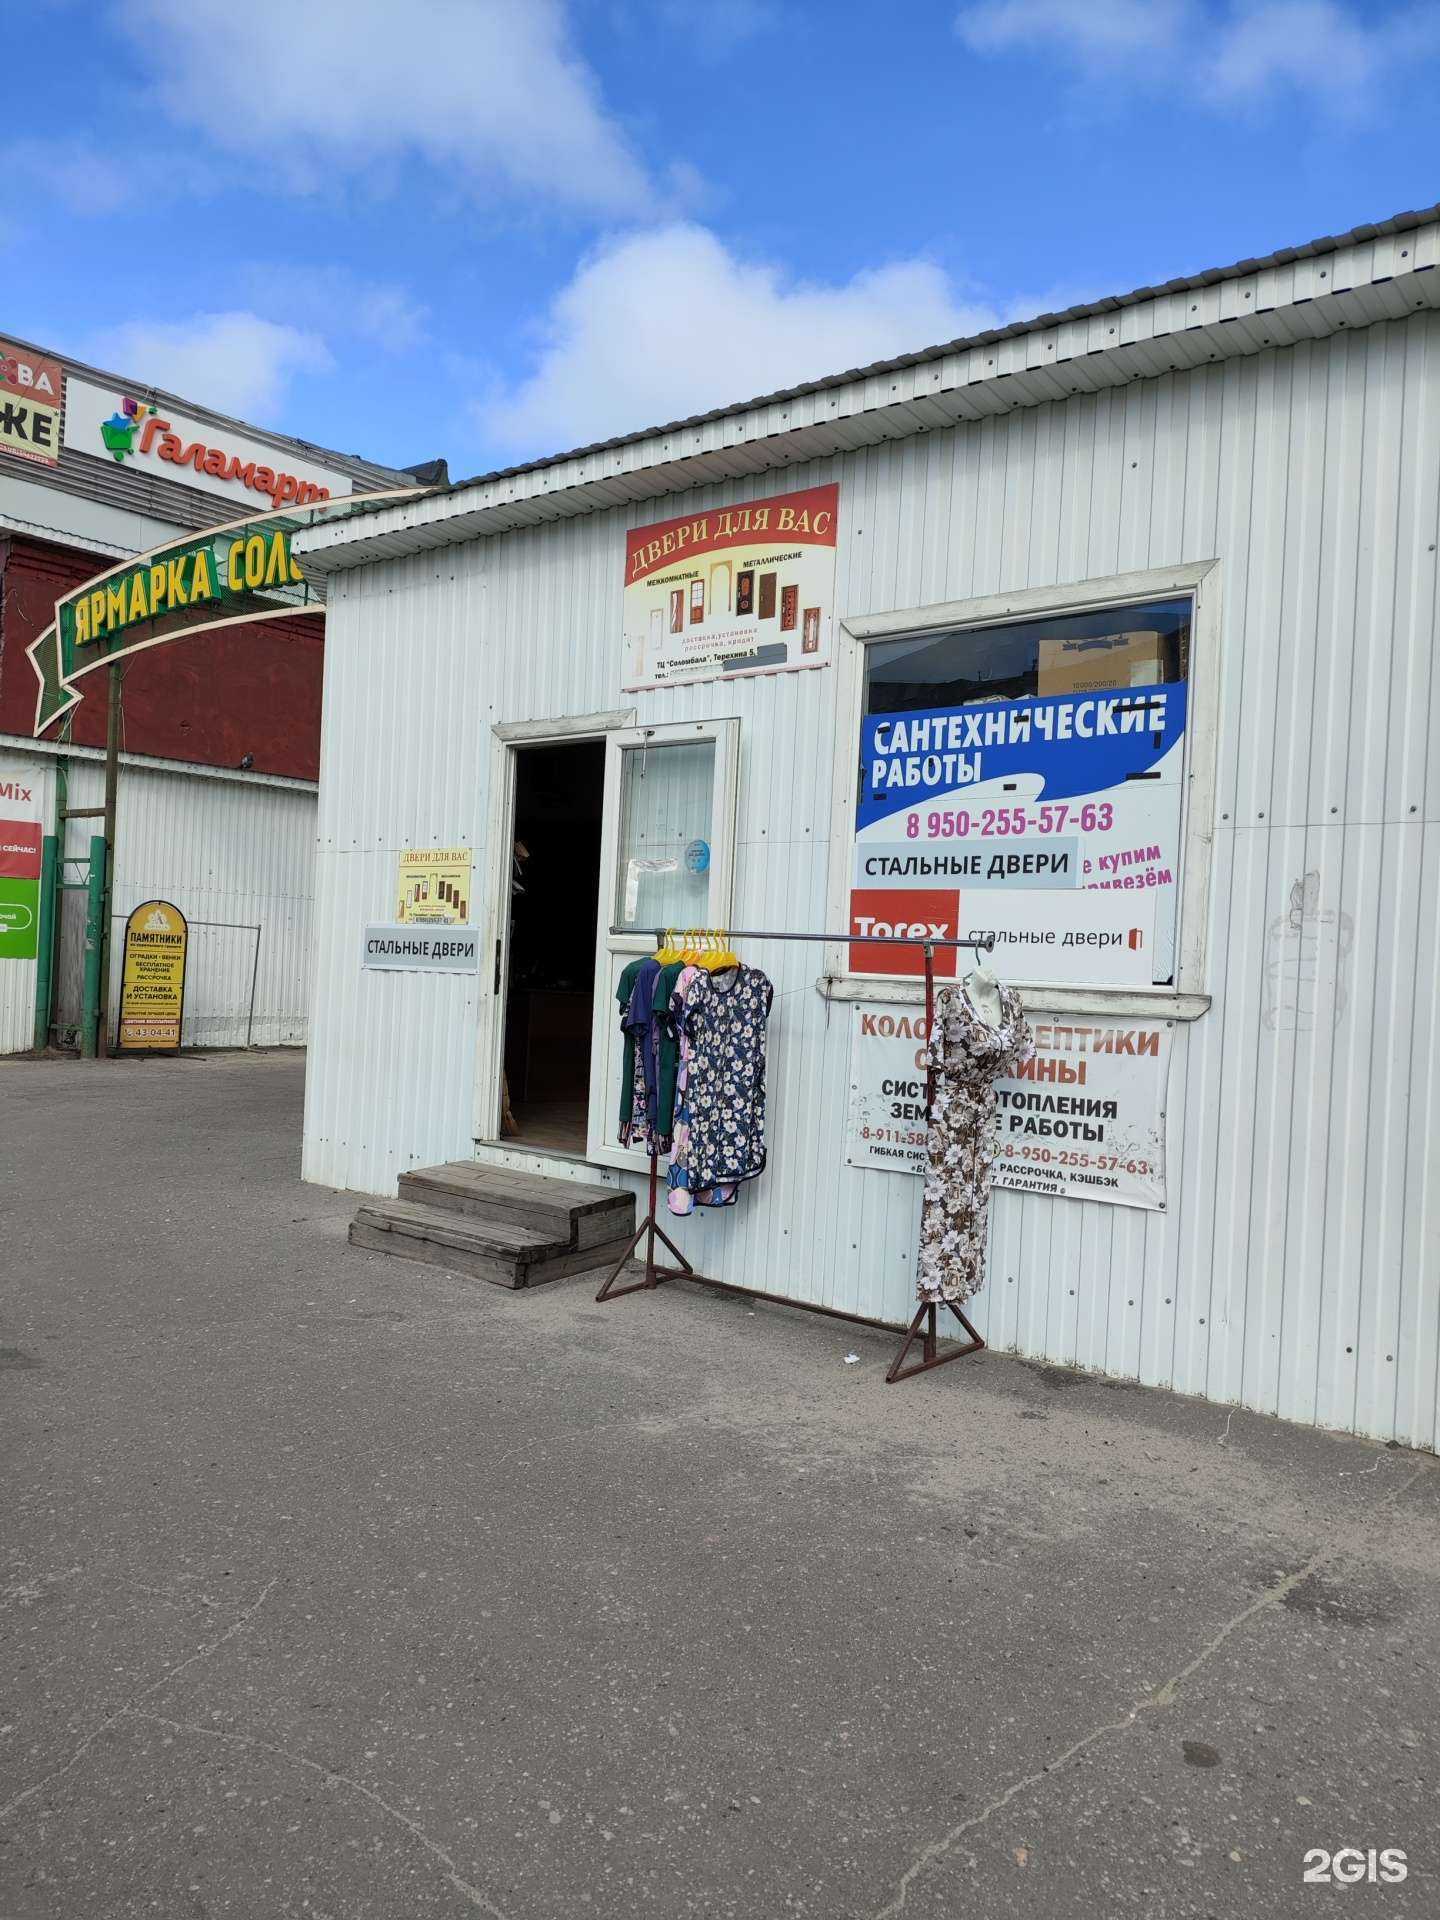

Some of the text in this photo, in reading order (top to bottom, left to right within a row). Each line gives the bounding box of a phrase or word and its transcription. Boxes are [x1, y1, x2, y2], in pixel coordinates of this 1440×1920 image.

[139, 418, 329, 513] Галамарт
[632, 508, 831, 577] ДВЕРИ ДЛЯ ВАС
[646, 551, 803, 587] МЕЖКОМНАТНЫЕ МЕТАЛЛИЧЕСКИЕ
[74, 549, 213, 646] ЯРМАРКА
[657, 661, 665, 669] ТЦ
[714, 650, 747, 661] Терехина
[874, 694, 1167, 755] САНТЕХНИЧЕСКИЕ
[872, 752, 982, 788] РАБОТЫ
[906, 803, 1113, 838] 8 950-255-57-63
[403, 852, 430, 863] ДВЕРИ
[865, 854, 1069, 879] СТАЛЬНЫЕ ДВЕРИ
[1098, 845, 1162, 873] купим
[130, 933, 182, 944] ПАМЯТНИКИ
[854, 917, 949, 940] Torex
[968, 929, 1122, 950] стальные двери
[367, 940, 474, 959] СТАЛЬНЫЕ ДВЕРИ
[1035, 1025, 1160, 1057] ЕПТИКИ
[994, 1090, 1118, 1119] ТОПЛЕНИЯ
[1010, 1115, 1104, 1142] РАБОТЫ
[869, 1145, 904, 1158] ГИБКАЯ
[1000, 1163, 1067, 1182] РАССРОЧКА,
[1070, 1171, 1119, 1187] КЭШБЭК
[1002, 1176, 1057, 1192] ГАРАНТИЯ
